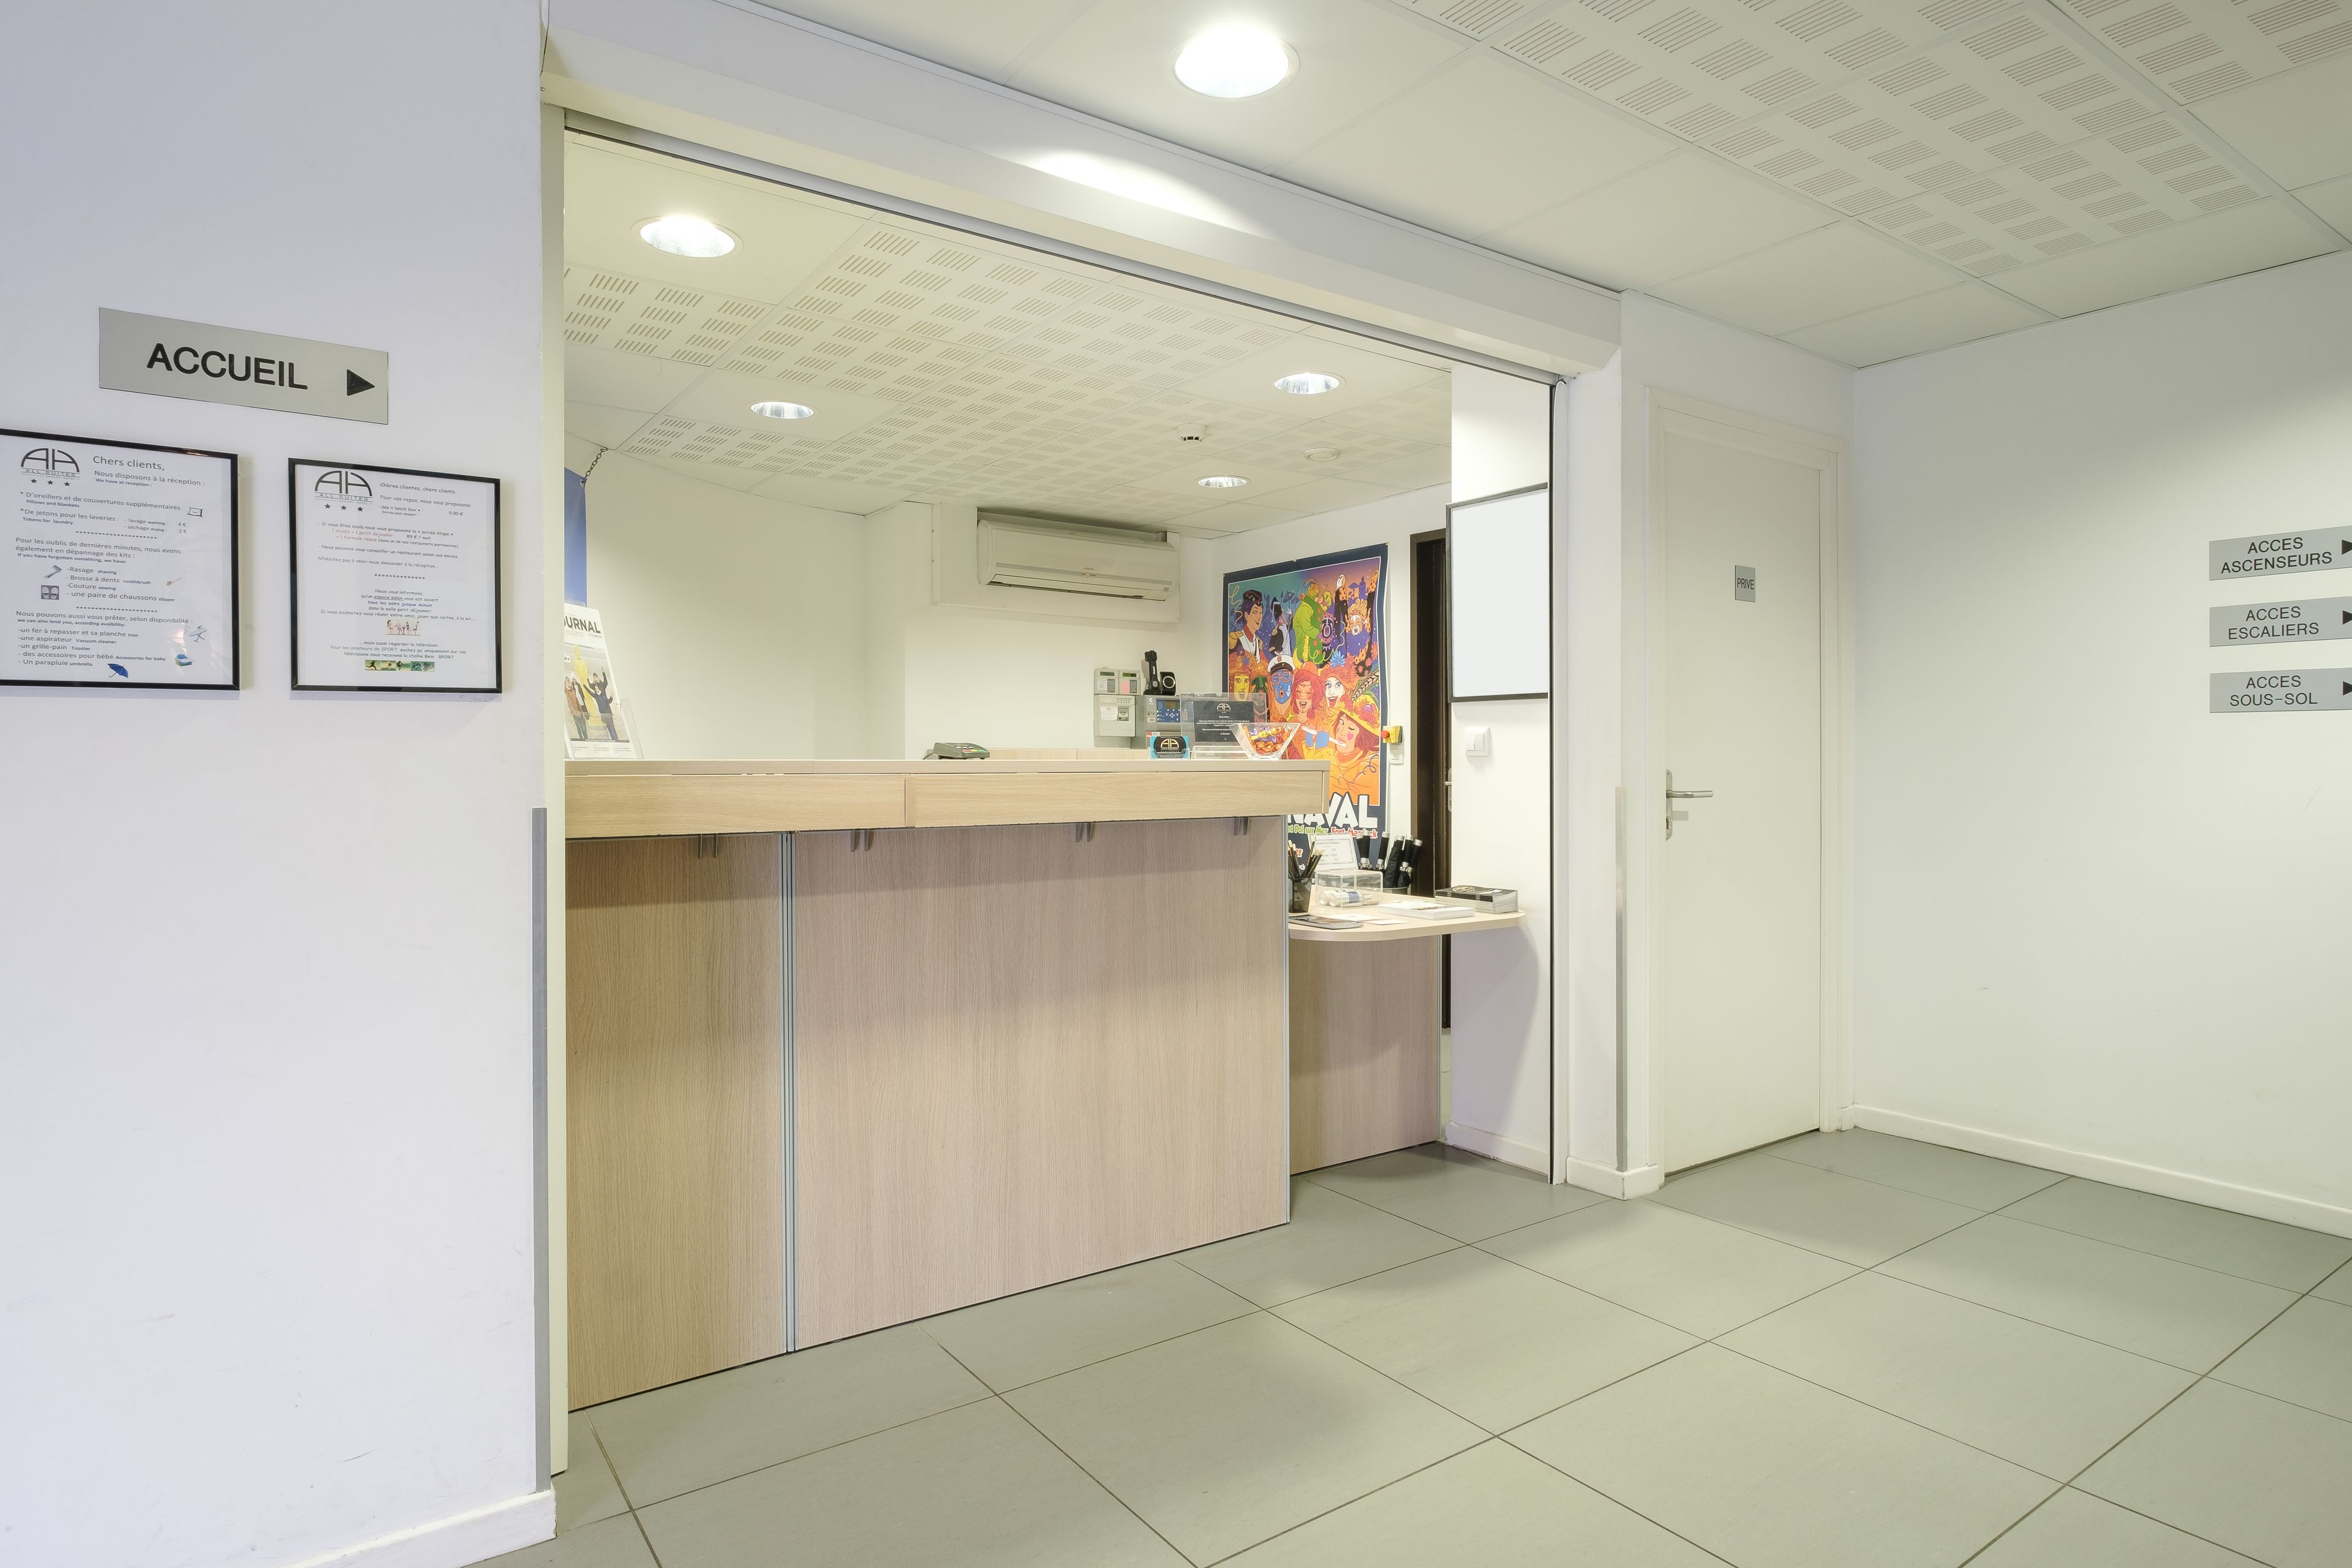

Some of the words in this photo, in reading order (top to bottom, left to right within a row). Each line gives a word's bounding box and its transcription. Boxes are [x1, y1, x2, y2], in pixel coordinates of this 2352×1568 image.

[146, 343, 308, 390] ACCUEIL
[93, 456, 124, 466] Chers
[127, 459, 164, 471] clients,
[126, 502, 180, 510] supplémentaires
[2247, 537, 2303, 554] ACCES
[2220, 552, 2332, 574] ASCENSEURS
[1737, 578, 1754, 589] PRIVE
[2245, 606, 2301, 622] ACCES
[2228, 622, 2319, 639] ESCALIERS
[2246, 675, 2301, 689] ACCES
[2230, 692, 2318, 706] SOUS-SOL
[1294, 824, 1305, 834] Pol
